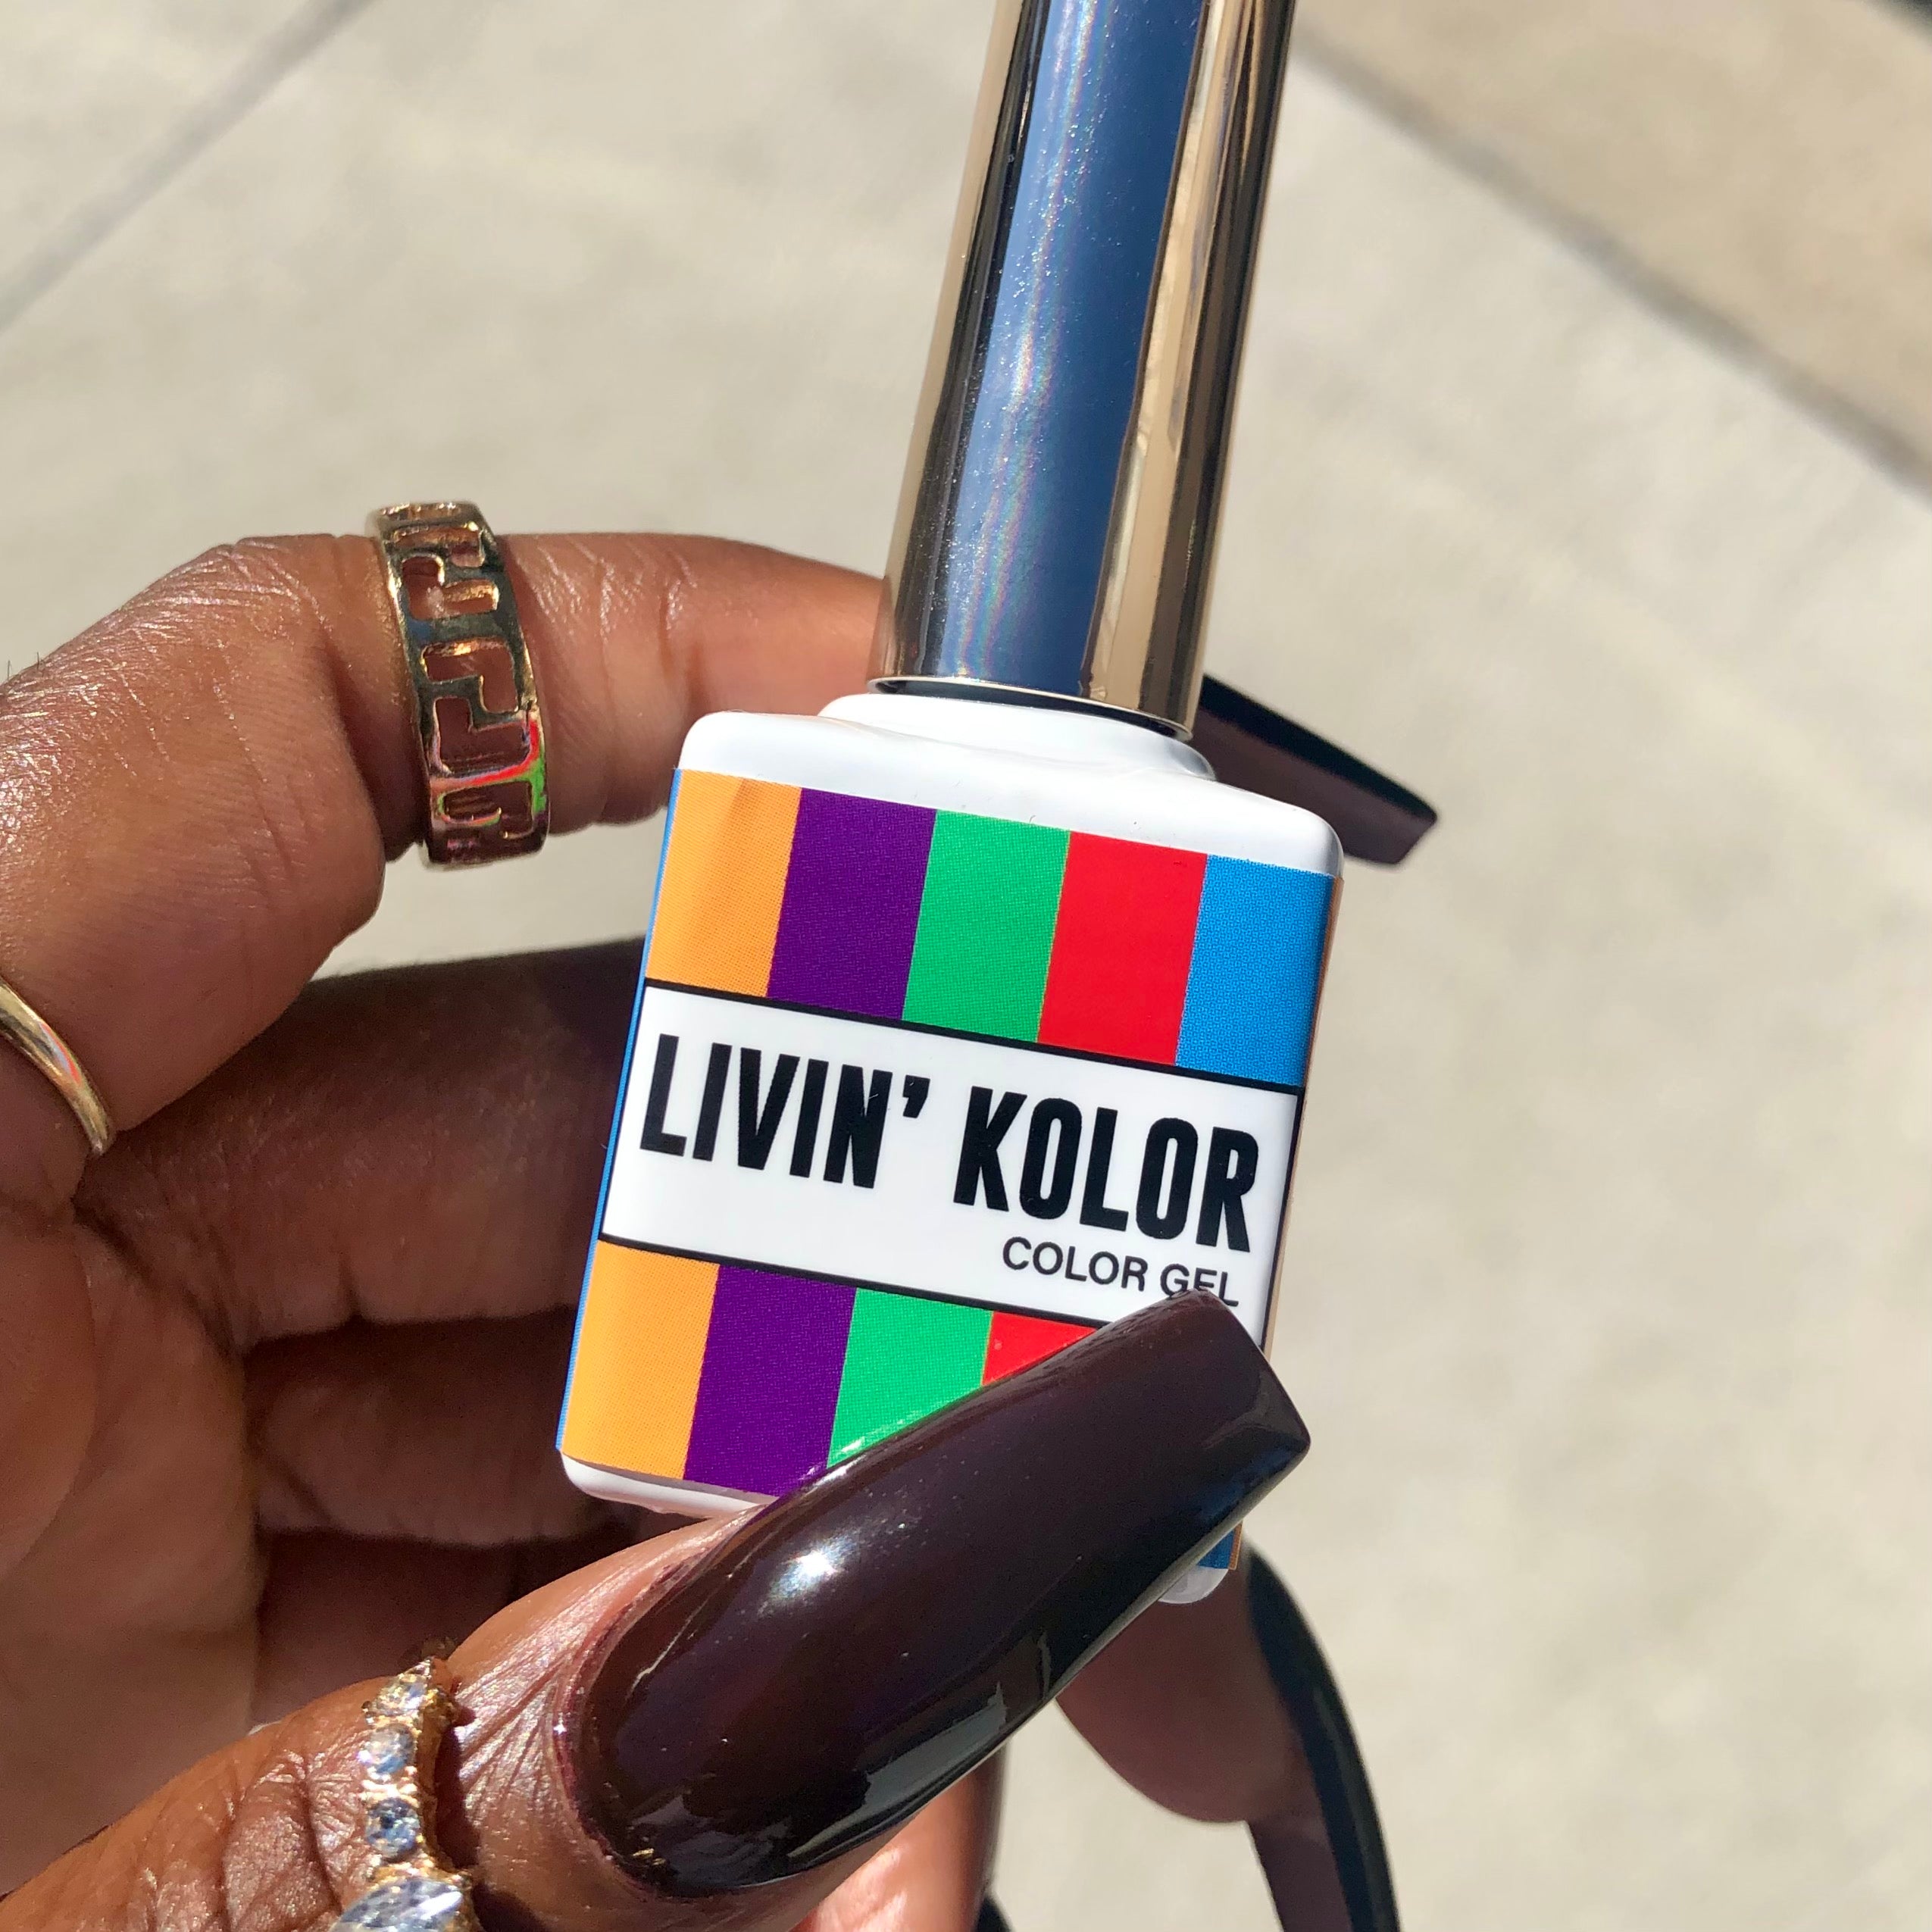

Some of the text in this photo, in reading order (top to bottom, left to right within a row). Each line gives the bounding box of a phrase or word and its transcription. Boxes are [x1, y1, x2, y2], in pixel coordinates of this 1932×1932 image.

[639, 1033, 1258, 1252] LIVIN' KOLOR
[1002, 1236, 1148, 1291] COLOR
